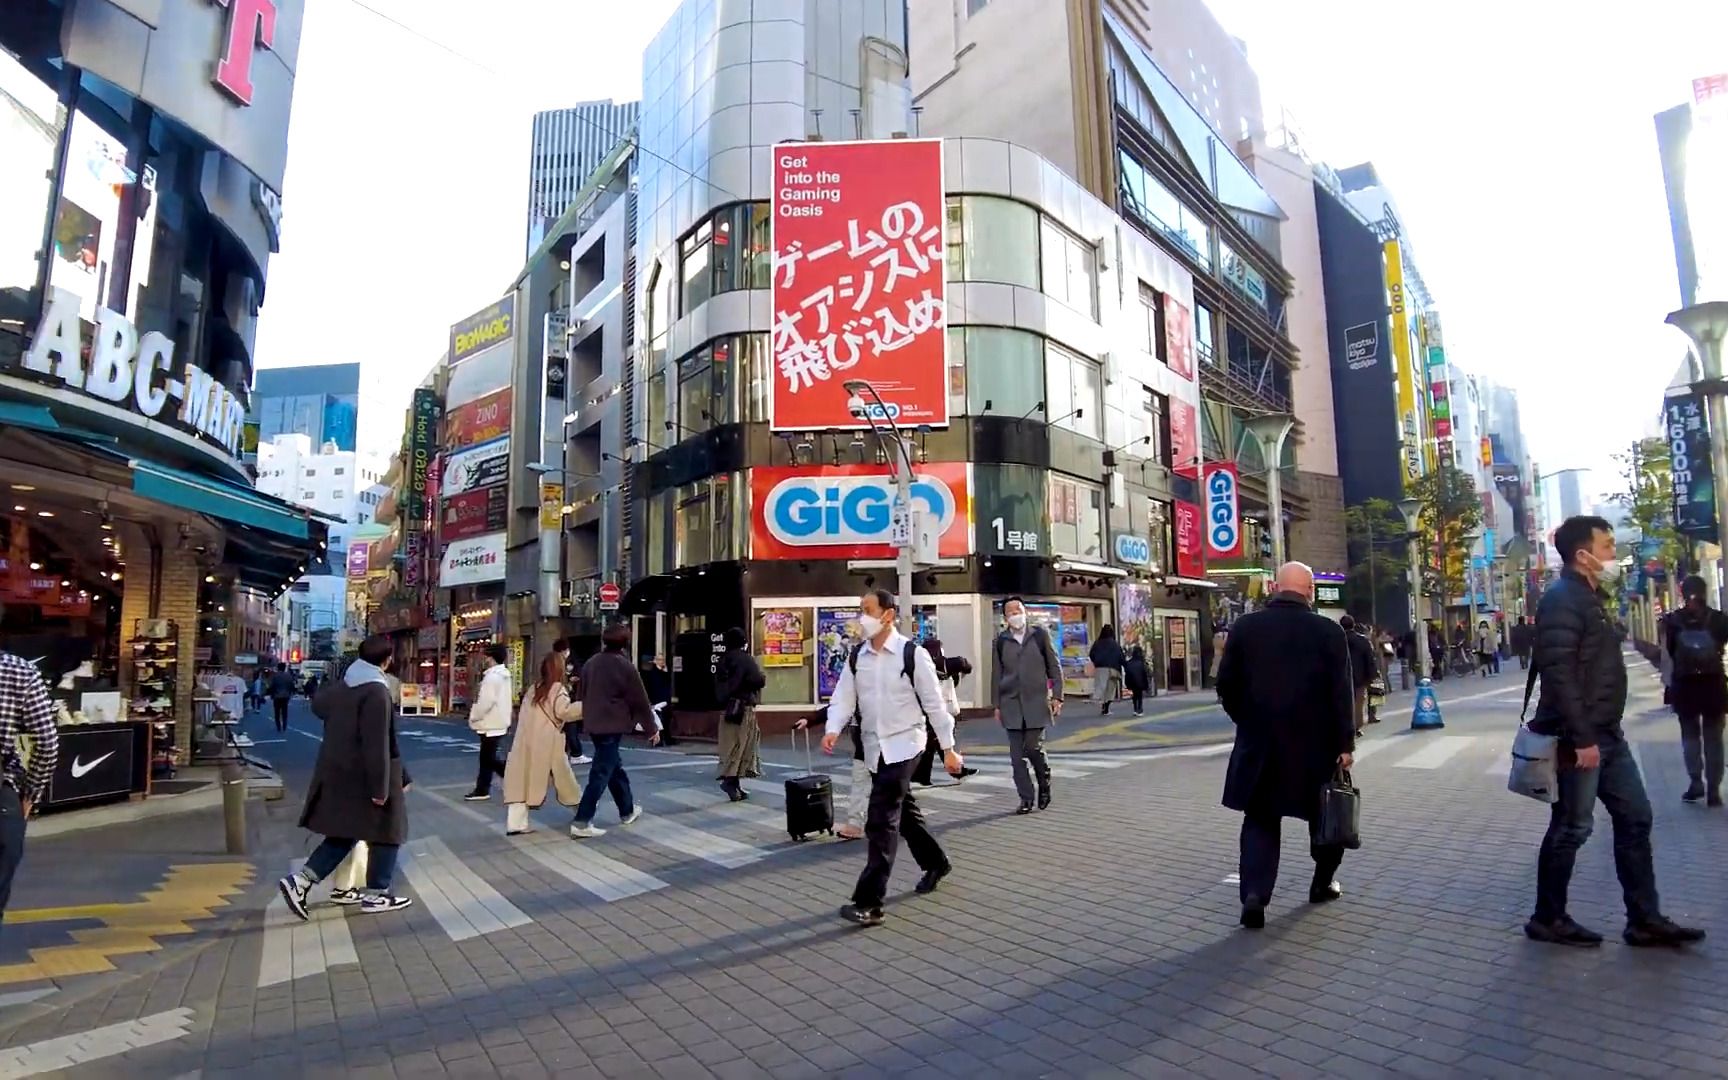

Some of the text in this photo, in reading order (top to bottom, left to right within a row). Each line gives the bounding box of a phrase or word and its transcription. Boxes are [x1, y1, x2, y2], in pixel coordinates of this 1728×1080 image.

[780, 155, 807, 168] Get
[816, 170, 840, 183] the
[780, 187, 840, 202] Gaming
[780, 203, 823, 217] Oasis
[774, 200, 924, 288] ゲームの
[774, 224, 943, 352] オアシスに
[777, 289, 944, 393] 飛び込め
[1211, 474, 1235, 547] GiGO
[992, 517, 1038, 551] 1号館
